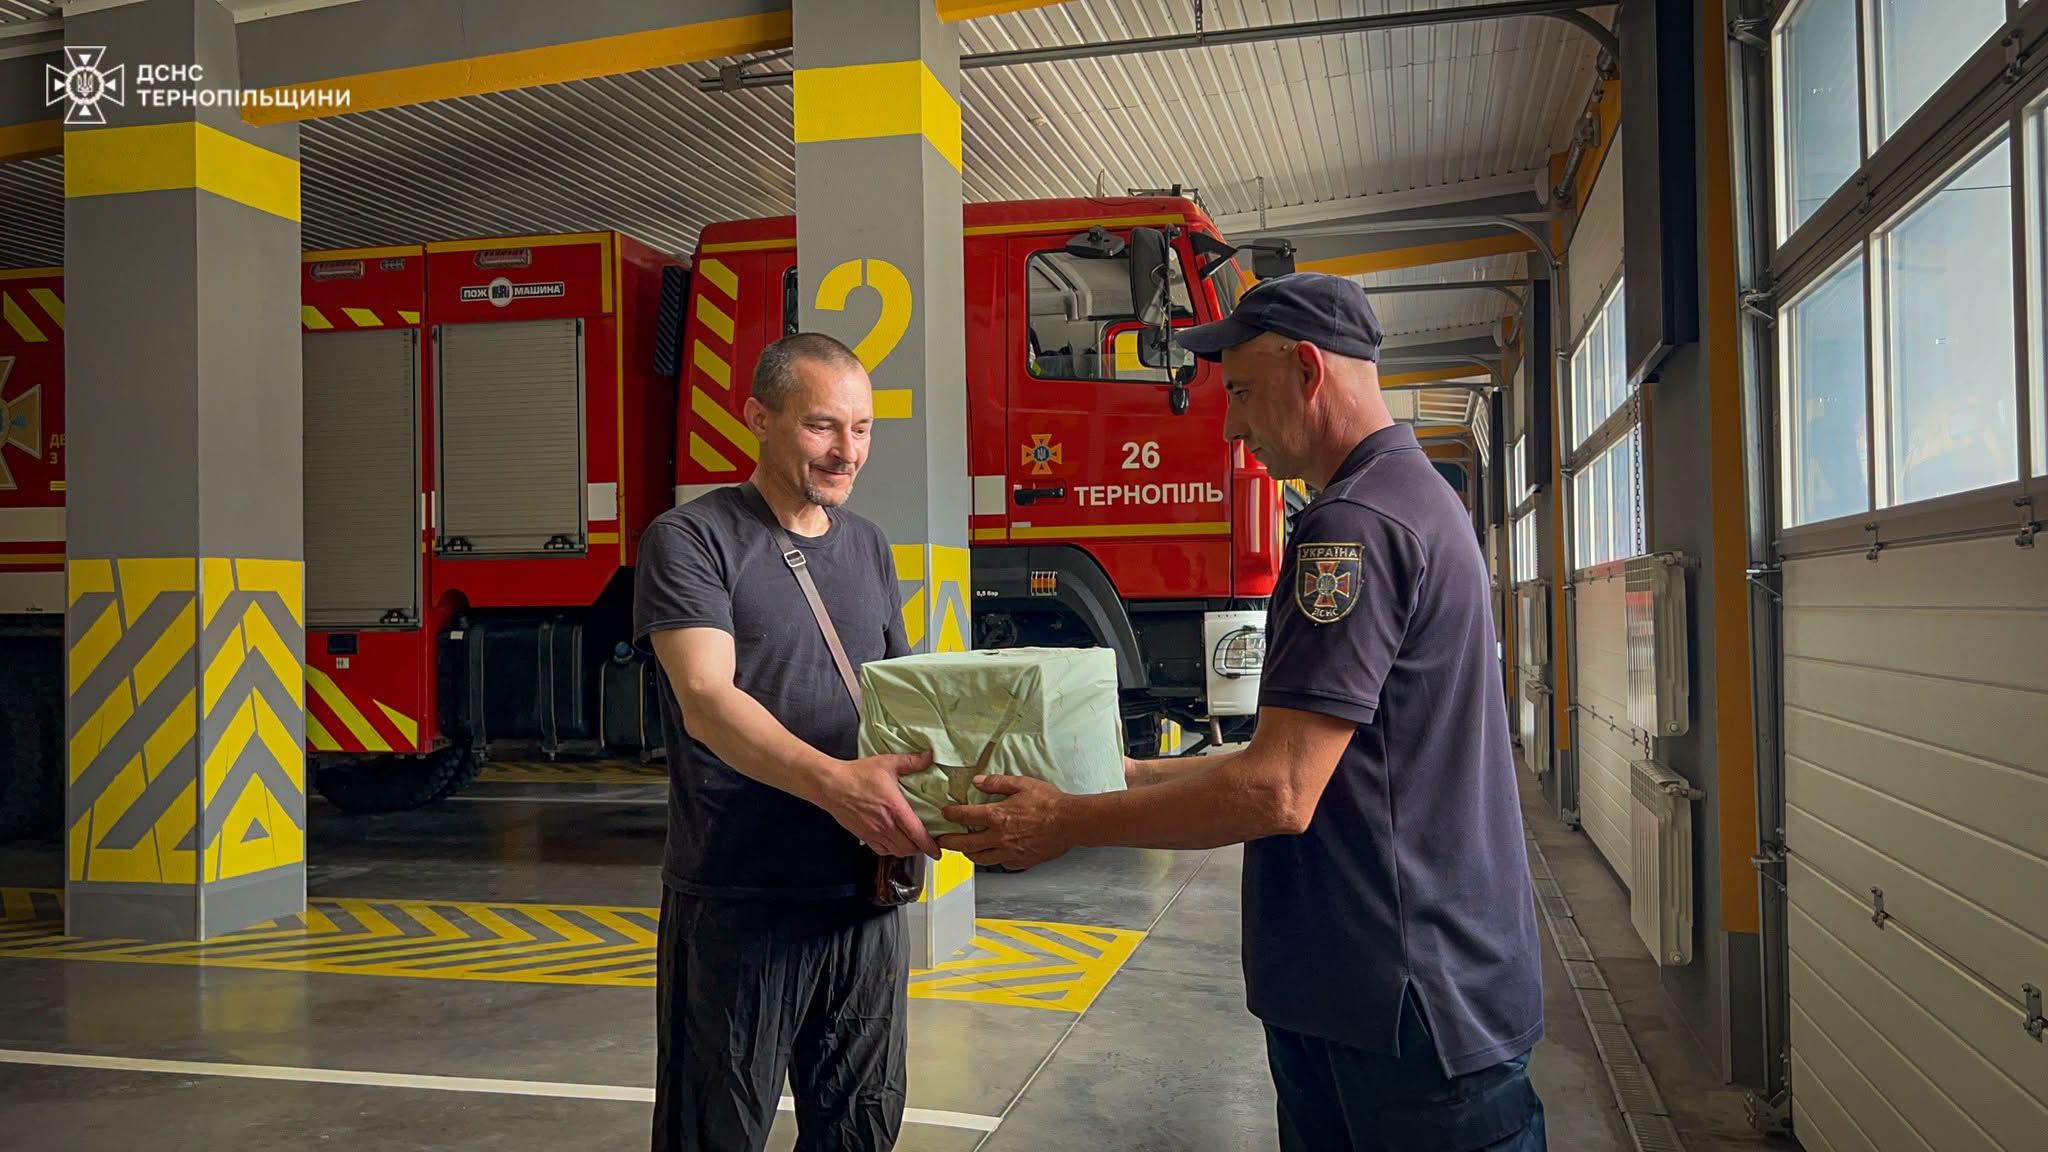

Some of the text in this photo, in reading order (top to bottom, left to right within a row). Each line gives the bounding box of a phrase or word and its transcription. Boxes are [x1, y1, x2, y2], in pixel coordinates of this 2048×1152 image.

[463, 288, 488, 299] ПОЖ
[815, 258, 913, 419] 2
[1121, 441, 1161, 470] 26
[1073, 482, 1224, 507] ТЕРНОПІЛЬ
[1302, 546, 1358, 558] УКРАЇНА
[1312, 607, 1339, 617] ДСНС
